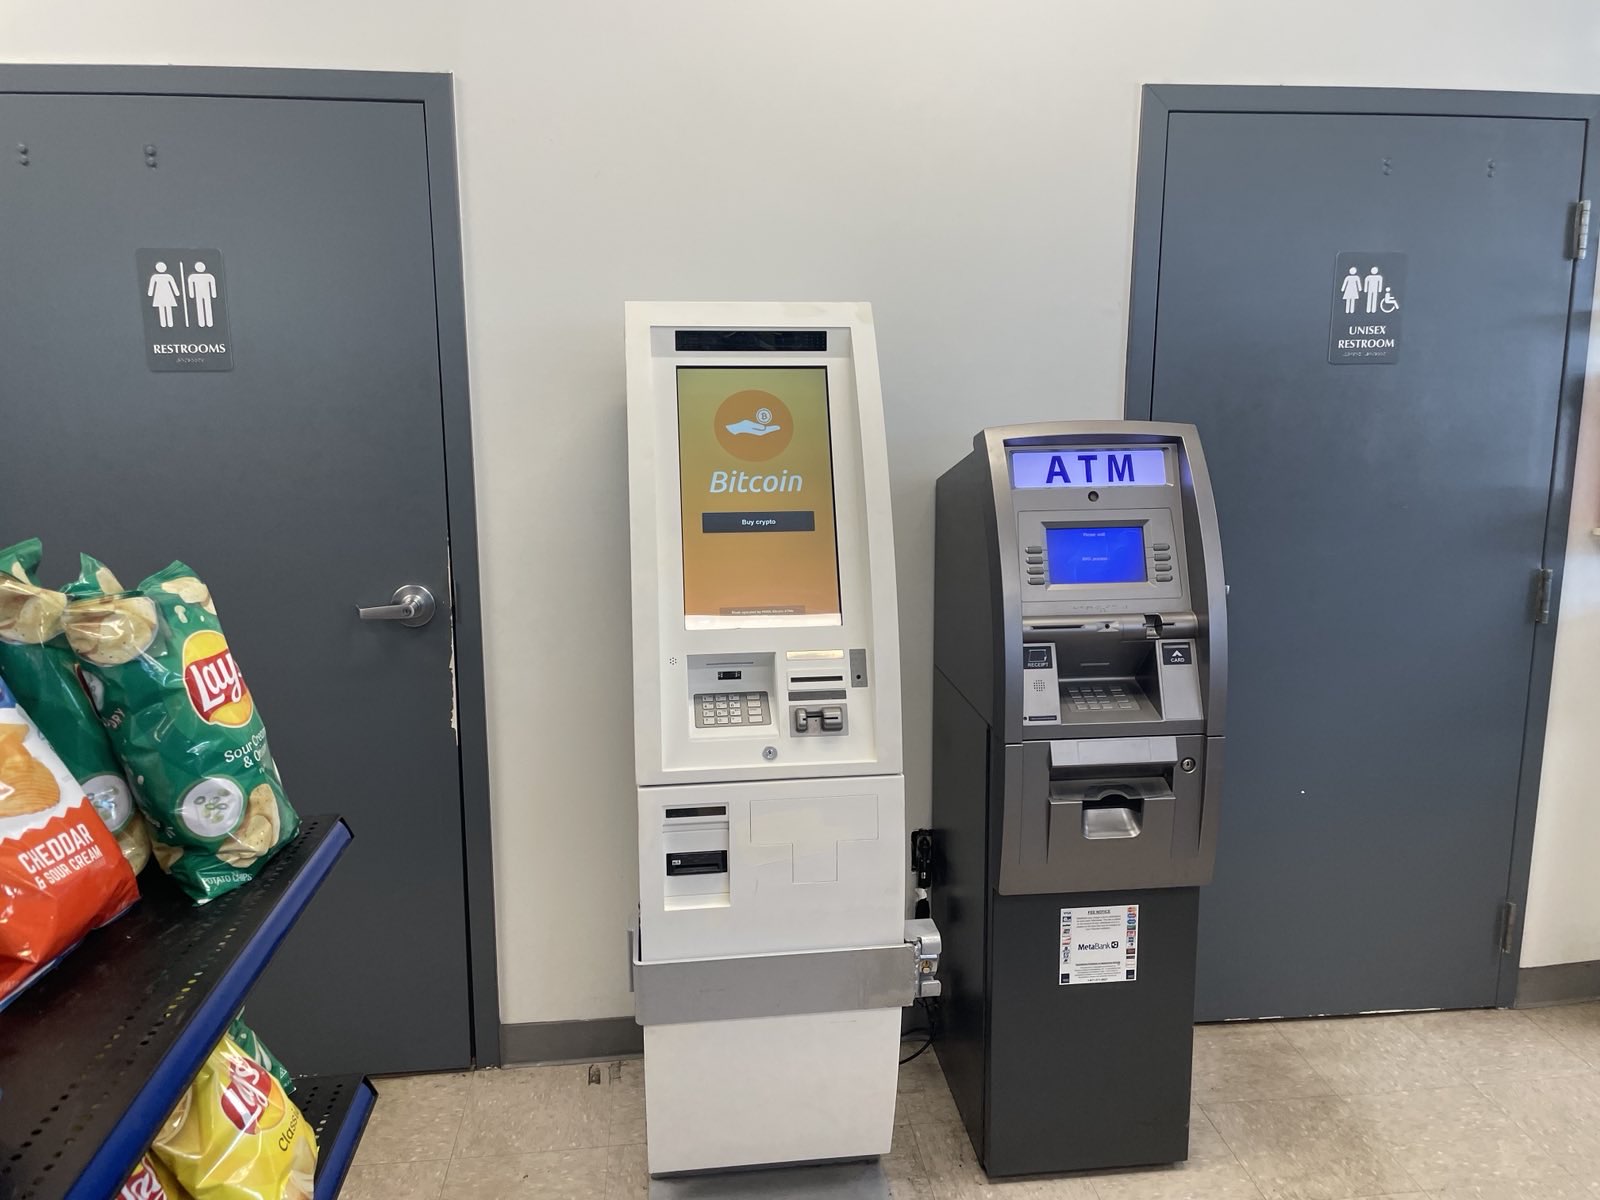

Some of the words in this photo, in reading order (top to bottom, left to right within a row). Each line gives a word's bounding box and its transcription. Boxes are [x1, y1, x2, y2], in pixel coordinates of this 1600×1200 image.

[1349, 325, 1386, 335] UNISEX
[153, 343, 226, 354] RESTROOMS
[1338, 339, 1394, 349] RESTROOM
[1045, 454, 1135, 484] ATM
[709, 470, 803, 493] Bitcoin
[741, 519, 754, 527] Buy
[756, 518, 776, 527] crypto
[224, 741, 253, 763] Sour
[243, 755, 254, 768] &
[17, 823, 94, 875] CHEDDAR
[34, 876, 47, 890] &
[43, 863, 72, 885] SOUR
[68, 844, 103, 871] CREAM
[232, 872, 253, 882] CHIPS
[1077, 942, 1111, 951] MetaBank
